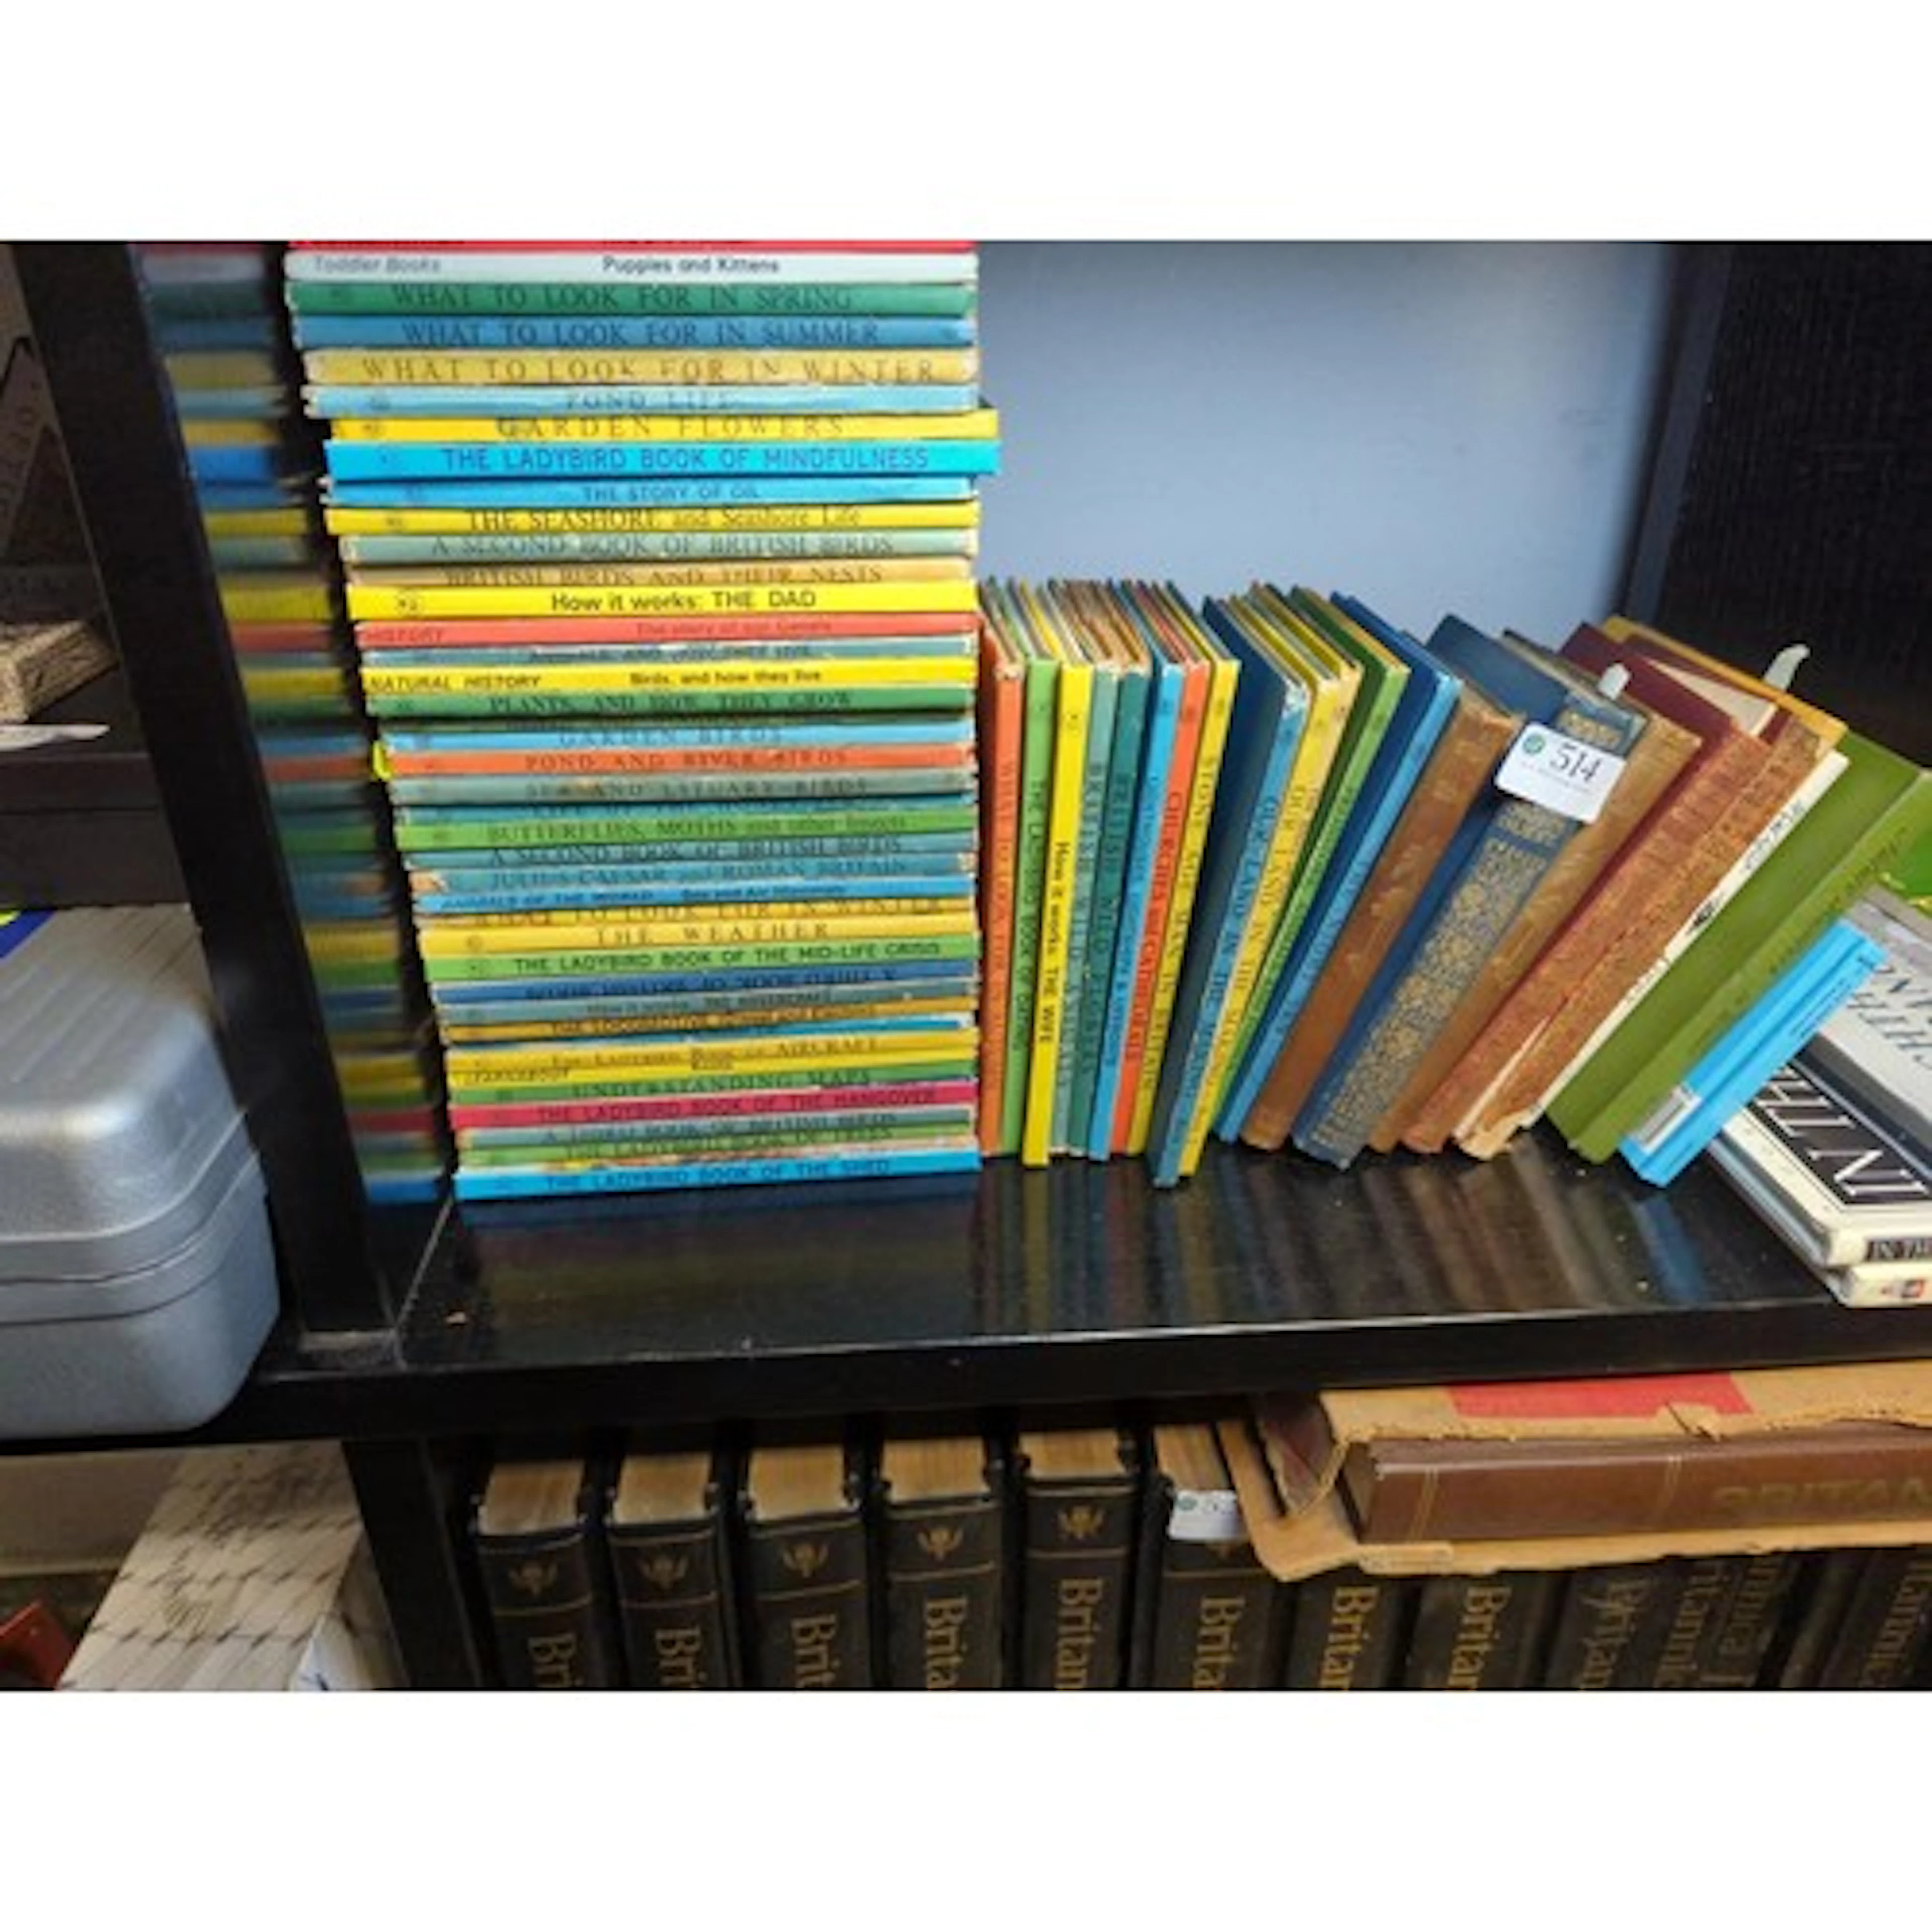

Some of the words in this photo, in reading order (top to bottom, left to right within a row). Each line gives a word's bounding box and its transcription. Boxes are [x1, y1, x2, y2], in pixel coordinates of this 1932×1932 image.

[314, 256, 380, 271] Toddler
[386, 256, 441, 272] Books
[603, 257, 672, 275] Puppies
[680, 257, 710, 272] and
[718, 257, 779, 272] Kittens
[391, 284, 470, 308] WHAT
[494, 284, 526, 307] TO
[544, 285, 619, 308] LOOK
[638, 285, 690, 308] FOR
[709, 285, 738, 307] IN
[755, 285, 852, 308] SPRING
[403, 324, 483, 346] WHAT
[505, 324, 537, 346] TO
[555, 324, 628, 345] LOOK
[647, 323, 703, 344] FOR
[717, 324, 744, 343] IN
[762, 322, 879, 345] SUMMER
[362, 359, 460, 380] WHAT
[486, 360, 526, 379] TO
[547, 359, 636, 380] LOOK
[661, 361, 725, 380] FOR
[747, 361, 778, 380] IN
[805, 360, 933, 381] WINTER
[566, 394, 646, 410] POND
[496, 417, 651, 437] GARDEN
[679, 416, 844, 436] FLOWERS
[443, 449, 491, 470] THE
[506, 448, 627, 469] LADYBIRD
[641, 448, 703, 468] BOOK
[719, 448, 751, 468] OF
[764, 447, 930, 469] MINDFULNESS
[582, 488, 617, 502] THE
[628, 487, 694, 502] STORY
[698, 486, 722, 499] OF
[729, 486, 761, 499] OIL
[469, 511, 516, 531] THE
[531, 510, 662, 531] SEASHORE
[671, 508, 711, 527] and
[721, 506, 809, 527] Seashore
[823, 505, 861, 525] Life
[432, 537, 449, 554] A
[462, 537, 566, 554] SECOND
[588, 536, 650, 554] BOOK
[663, 536, 692, 553] OF
[708, 534, 807, 553] BRITISH
[819, 533, 894, 552] BIRDS
[445, 568, 546, 586] BRITISH
[559, 568, 635, 585] BIRDS
[649, 569, 704, 584] AND
[721, 567, 795, 583] THEIR
[811, 566, 883, 582] NESTS
[551, 592, 603, 611] How
[609, 592, 624, 610] it
[629, 592, 703, 610] works:
[711, 591, 756, 608] THE
[768, 590, 817, 607] DAD
[370, 675, 451, 691] NATURAL
[464, 674, 541, 689] HISTORY
[680, 672, 711, 684] and
[715, 671, 749, 683] how
[754, 669, 789, 684] they
[794, 669, 822, 682] live
[489, 695, 570, 712] PLANTS
[594, 694, 635, 710] AND
[524, 754, 598, 772] POND
[615, 753, 666, 769] AND
[682, 752, 754, 767] RIVER
[1028, 778, 1046, 813] THE
[1280, 783, 1307, 832] OUR
[656, 819, 737, 838] MOTHS
[1253, 794, 1280, 844] OUR
[1152, 791, 1181, 902] CHURCHES
[1023, 821, 1043, 905] LADYBIRD
[1055, 841, 1071, 881] How
[1231, 858, 1261, 919] LAND
[1258, 847, 1290, 909] LAND
[1052, 887, 1066, 901] it
[597, 928, 655, 945] THE
[683, 923, 828, 942] WEATHER
[1249, 920, 1264, 942] IN
[1221, 931, 1240, 957] IN
[513, 957, 550, 973] THE
[559, 954, 653, 972] LADYBIRD
[661, 951, 712, 967] BOOK
[721, 949, 746, 963] OF
[756, 947, 789, 961] THE
[798, 944, 879, 959] MID-LIFE
[884, 942, 940, 955] CRISIS
[1044, 966, 1059, 998] THE
[1233, 958, 1255, 994] THE
[1126, 937, 1158, 1063] CATHEDRALS
[1206, 971, 1230, 1011] THE
[1039, 1004, 1056, 1043] WIFE
[537, 1107, 565, 1120] THE
[575, 1101, 681, 1119] LADYBIRD
[690, 1097, 742, 1114] BOOK
[754, 1095, 778, 1111] OF
[790, 1093, 823, 1110] THE
[834, 1088, 937, 1108] HANGOVER
[544, 1174, 580, 1189] THE
[592, 1169, 690, 1187] LADYBIRD
[698, 1166, 750, 1182] BOOK
[760, 1164, 787, 1178] OF
[794, 1161, 830, 1177] THE
